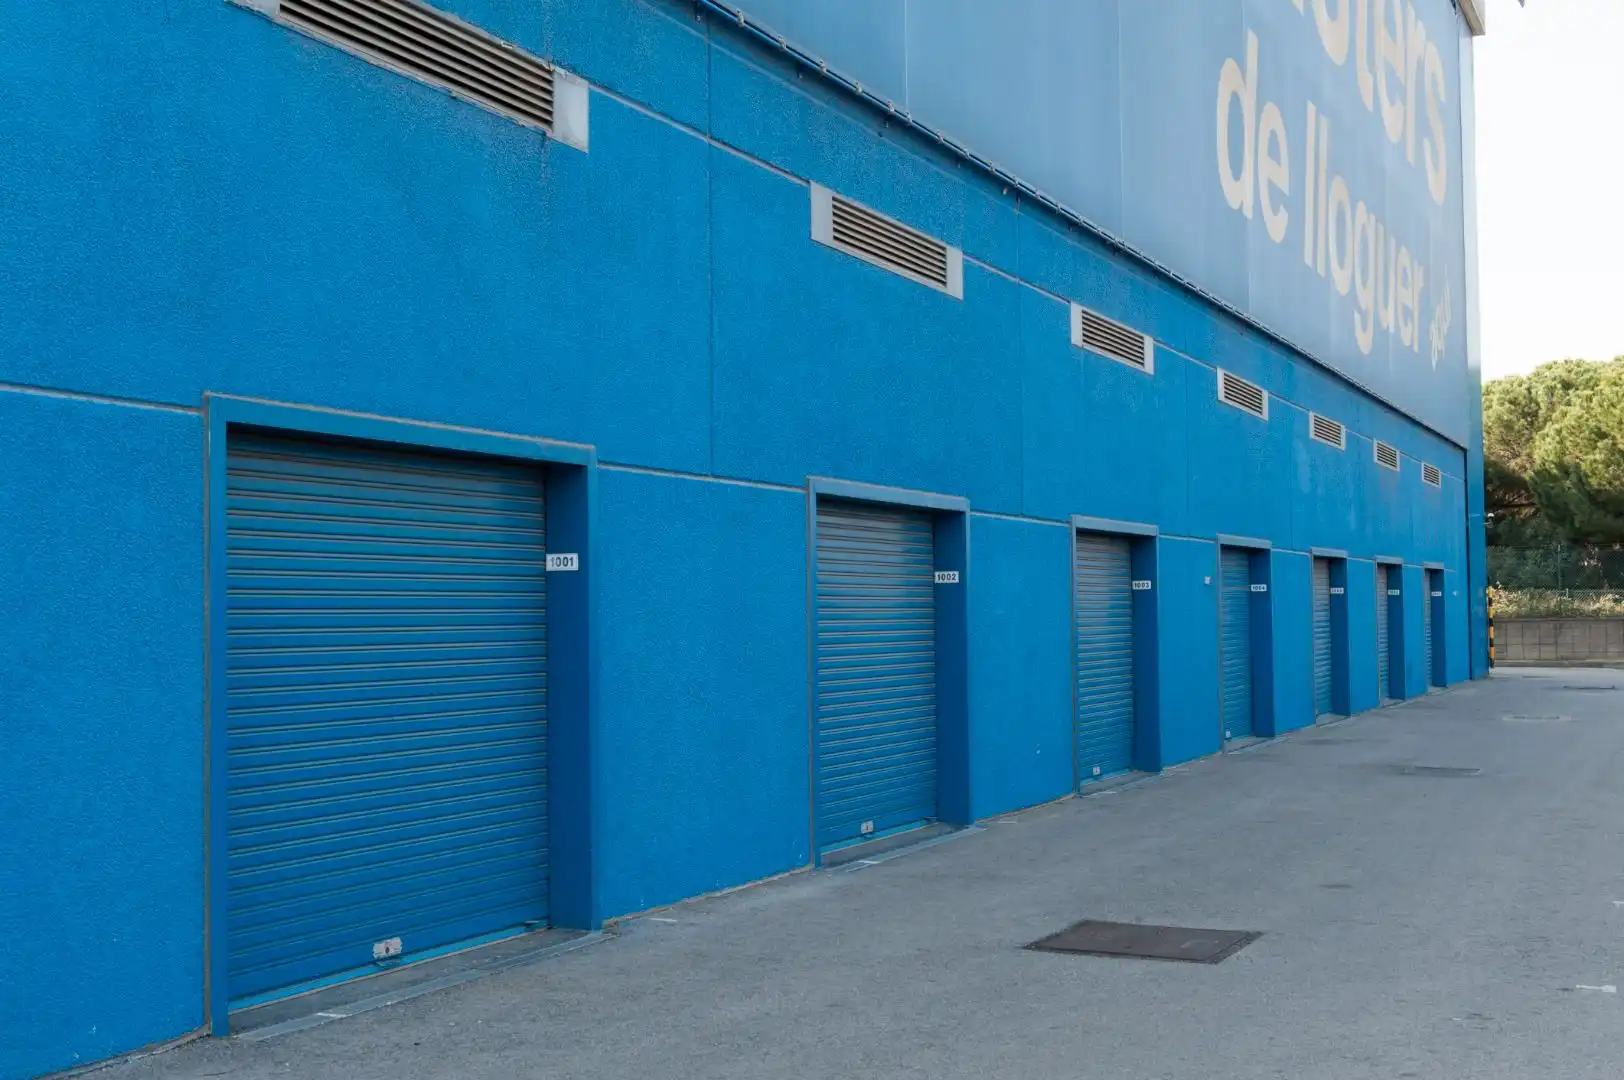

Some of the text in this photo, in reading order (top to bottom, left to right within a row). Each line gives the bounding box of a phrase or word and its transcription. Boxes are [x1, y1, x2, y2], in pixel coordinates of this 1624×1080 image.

[1216, 28, 1424, 355] de lloguer
[550, 556, 575, 568] 1001
[937, 572, 957, 582] 1002
